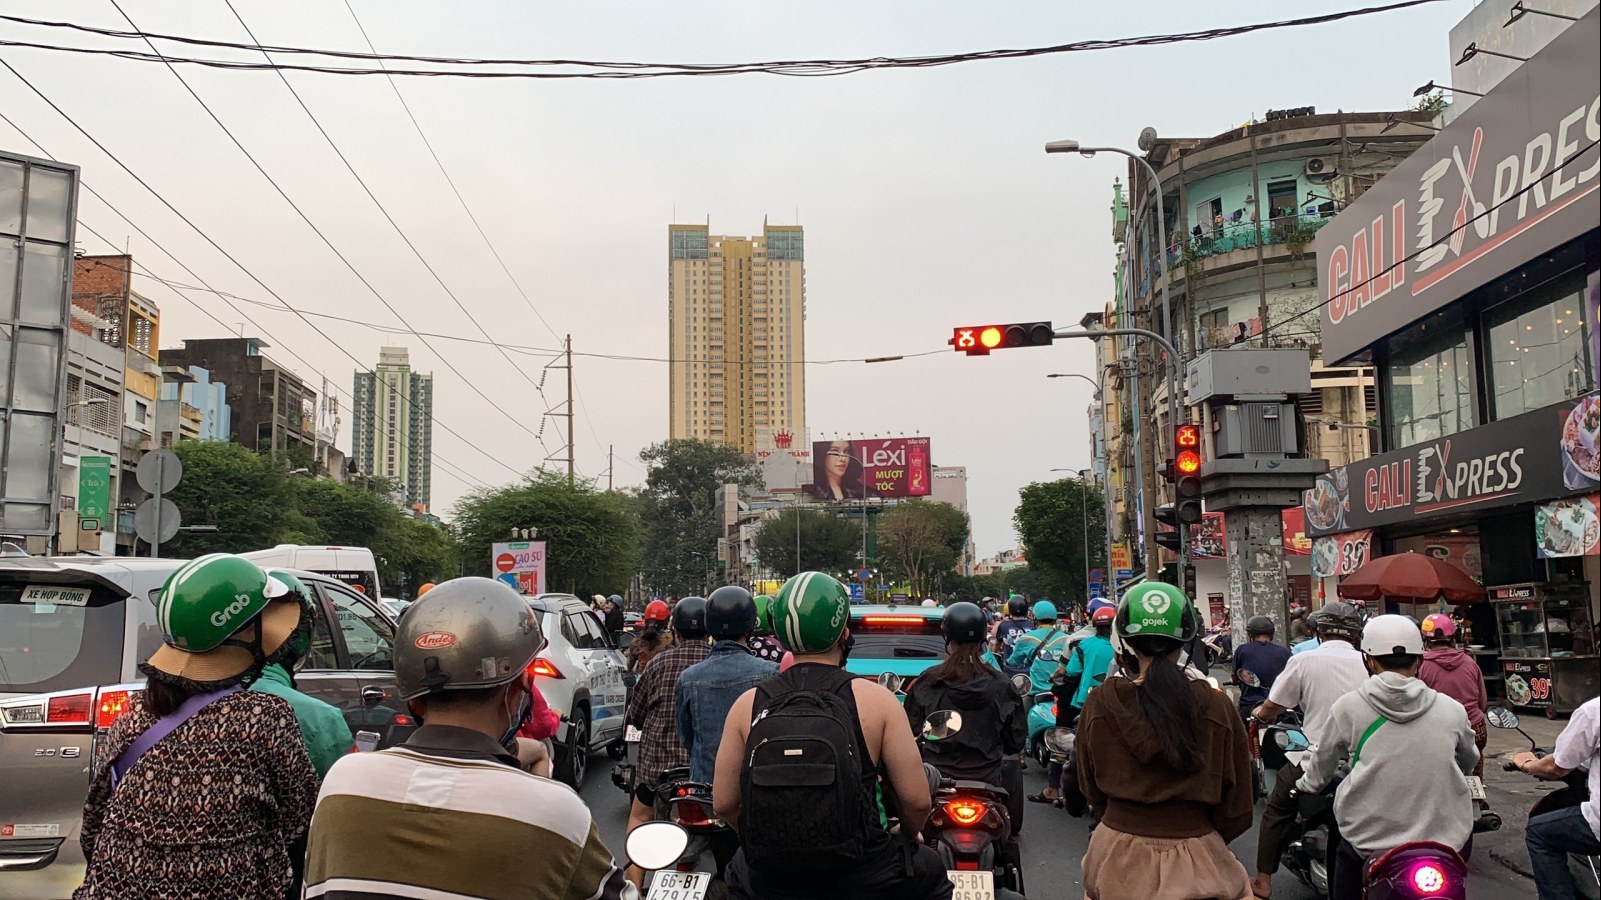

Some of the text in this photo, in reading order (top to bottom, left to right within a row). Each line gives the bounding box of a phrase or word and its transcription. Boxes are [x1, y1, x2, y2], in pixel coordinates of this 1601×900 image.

[1328, 199, 1405, 325] CALI
[1180, 429, 1195, 445] 25
[862, 440, 905, 468] Léxi
[875, 481, 895, 491] TÓC
[1364, 439, 1524, 513] CALI EXPRESS
[515, 553, 529, 564] CAO
[27, 590, 40, 599] XE
[211, 594, 250, 627] Grab
[830, 596, 846, 628] Grab
[1142, 618, 1168, 627] gojek
